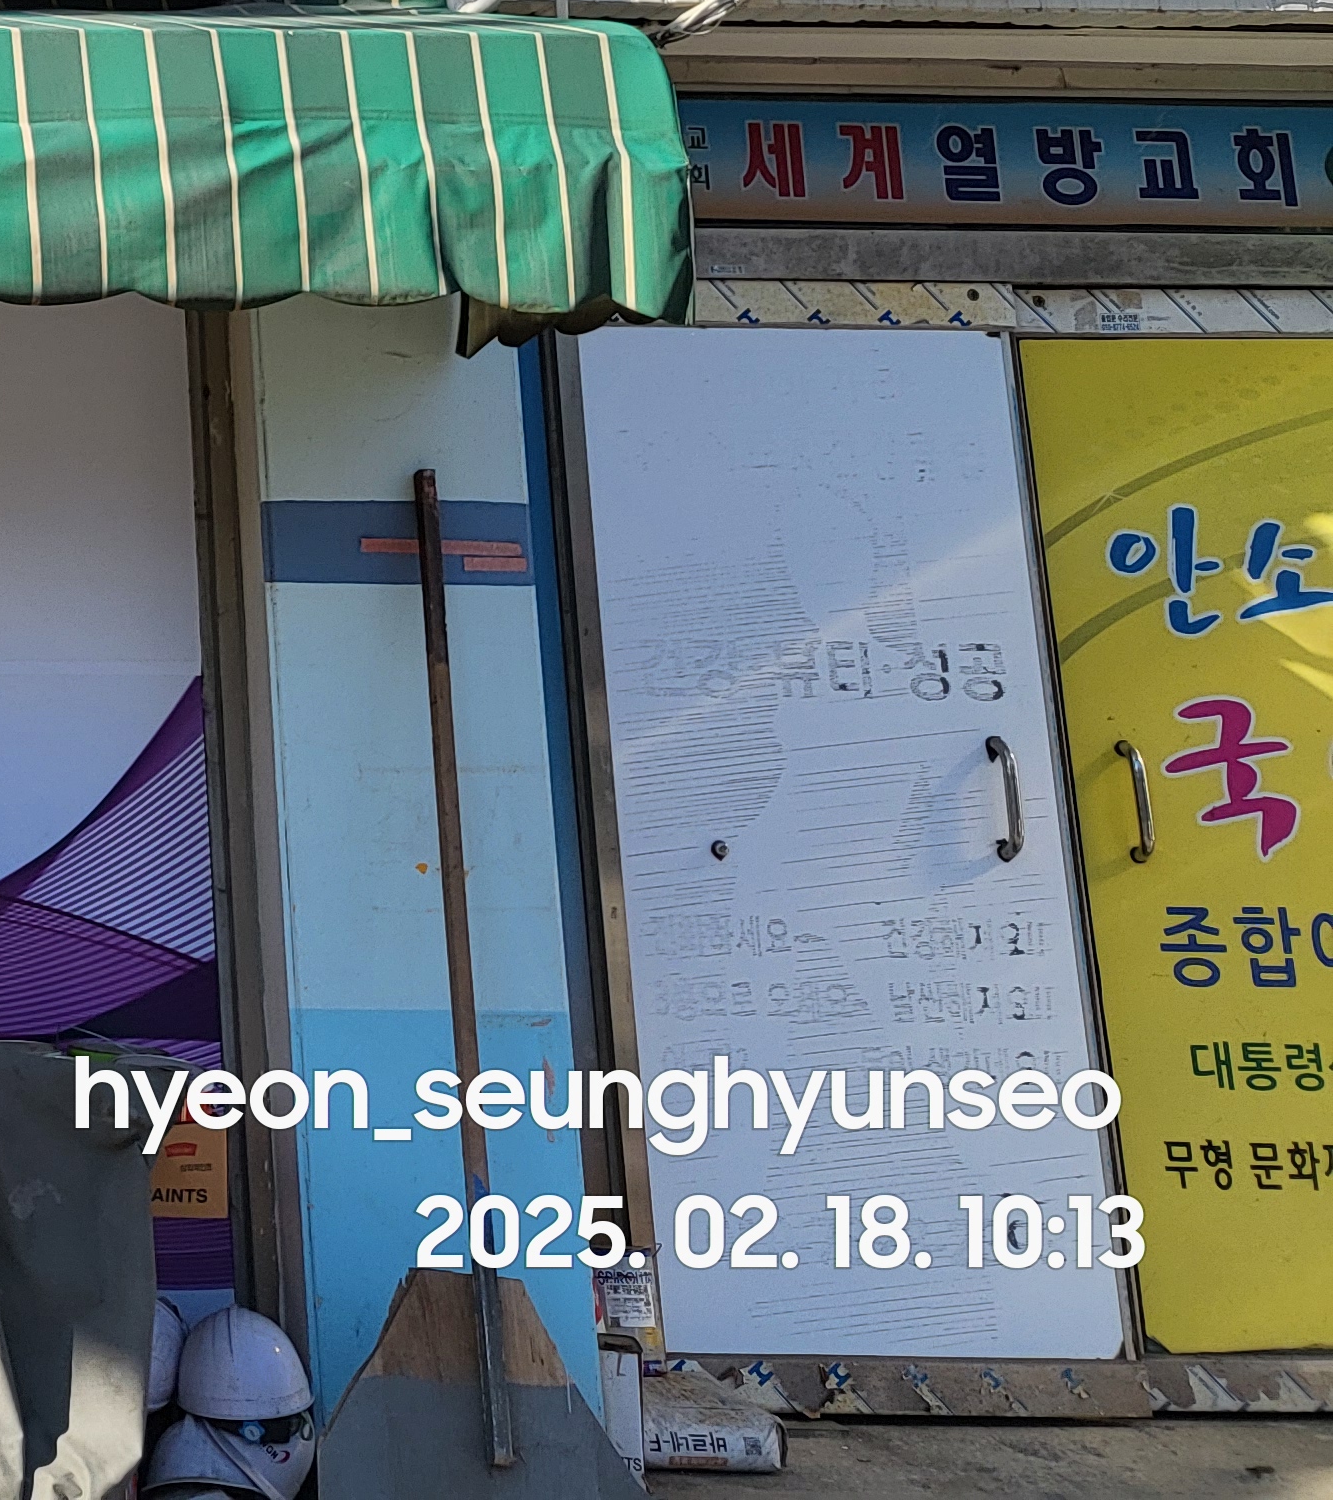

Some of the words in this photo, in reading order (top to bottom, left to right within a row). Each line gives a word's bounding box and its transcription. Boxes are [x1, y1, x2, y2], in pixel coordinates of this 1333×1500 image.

[1165, 697, 1299, 862] 국
[1190, 1040, 1333, 1092] 대통령
[1164, 1138, 1234, 1192] 무형
